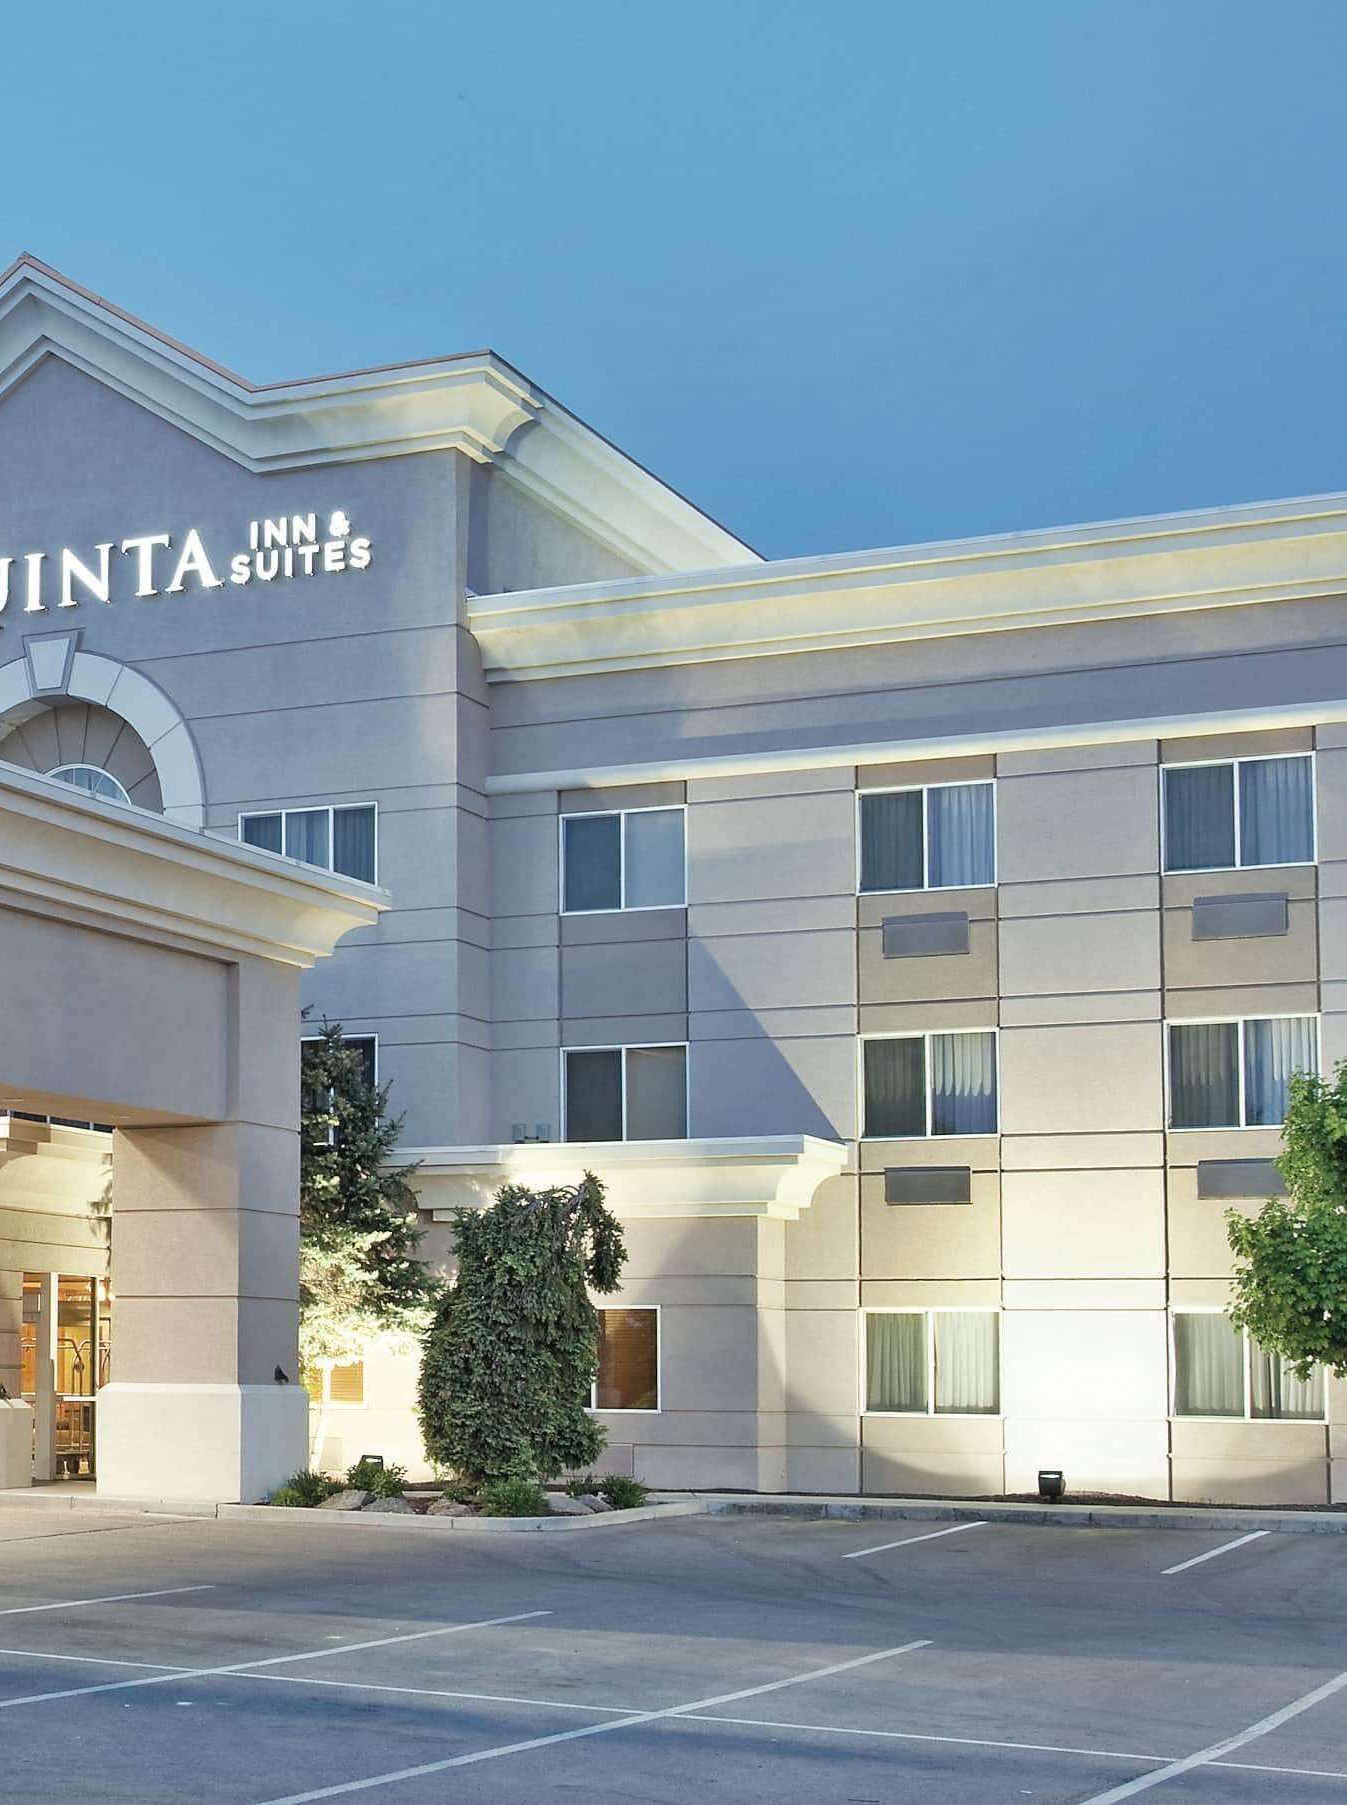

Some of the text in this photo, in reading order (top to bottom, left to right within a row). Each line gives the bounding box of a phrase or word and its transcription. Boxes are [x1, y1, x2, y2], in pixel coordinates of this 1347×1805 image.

[249, 510, 351, 551] INN &
[229, 537, 373, 585] SUITES
